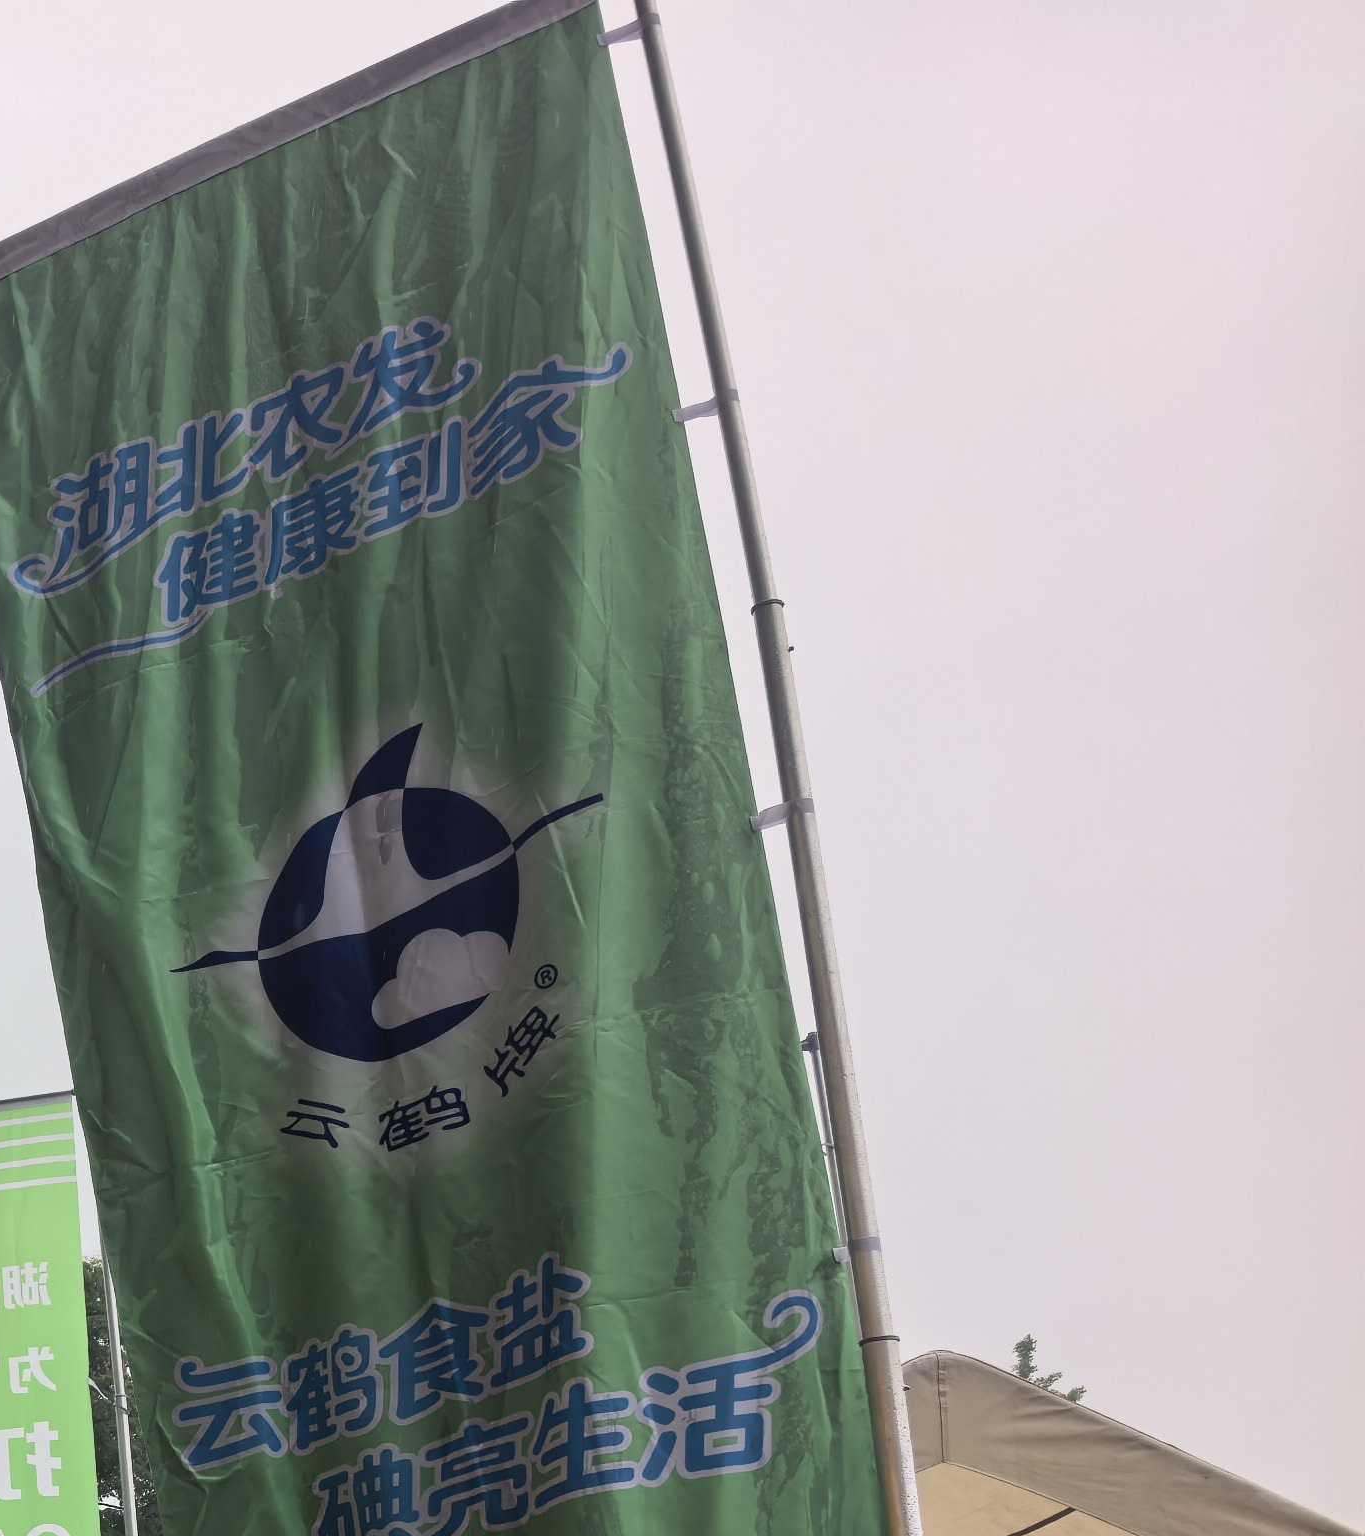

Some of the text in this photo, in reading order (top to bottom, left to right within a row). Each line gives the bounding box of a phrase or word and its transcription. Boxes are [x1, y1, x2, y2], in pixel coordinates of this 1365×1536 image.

[14, 318, 477, 597] 湖北农发
[157, 343, 631, 627] 健康到家
[280, 1006, 560, 1152] 云鹤牌
[175, 1252, 592, 1471] 云鹤食盐
